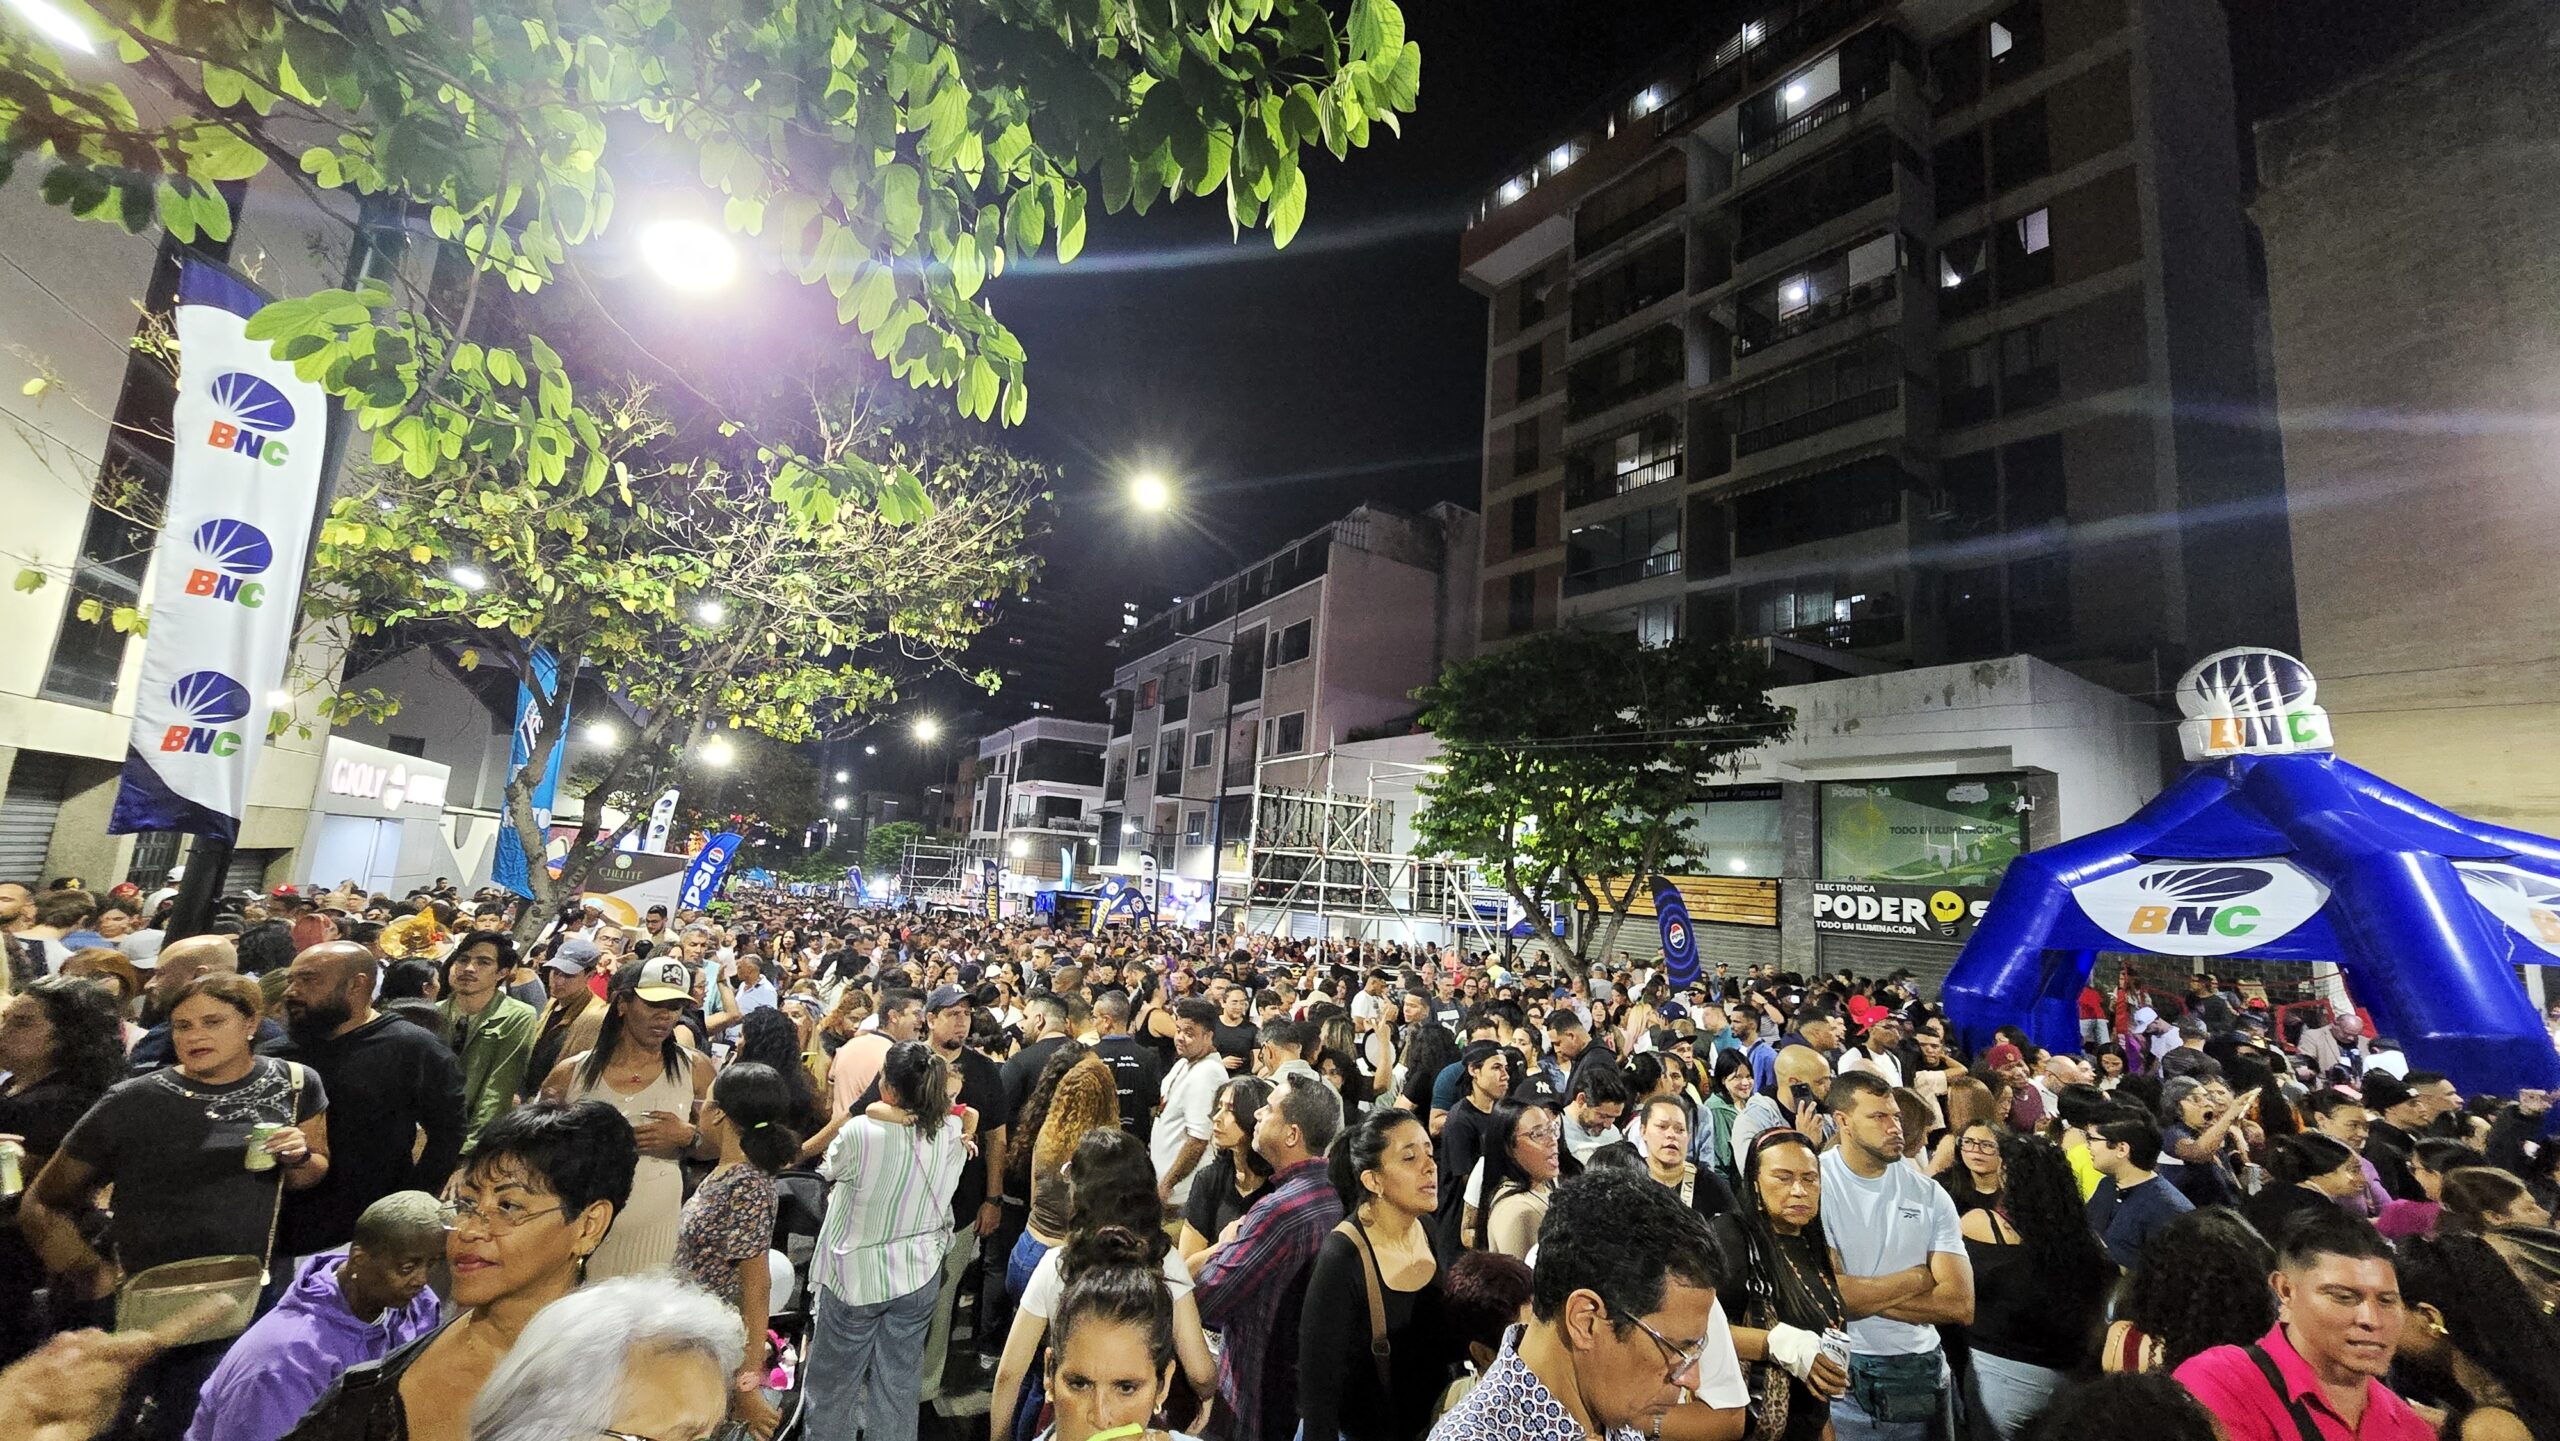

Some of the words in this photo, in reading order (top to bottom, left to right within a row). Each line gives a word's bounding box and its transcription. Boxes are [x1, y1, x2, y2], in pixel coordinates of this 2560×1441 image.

[208, 420, 289, 466] BNC
[185, 568, 265, 608] BNC
[160, 725, 241, 757] BNC
[2210, 711, 2318, 749] BNC
[1889, 826, 1917, 834] TODO
[681, 861, 716, 912] PSI
[1815, 883, 1875, 893] ELECTRONICA
[1815, 920, 1841, 929] TODO
[1842, 922, 1854, 930] EN
[1855, 923, 1916, 935] ILUMINACION
[2128, 905, 2261, 937] BNC
